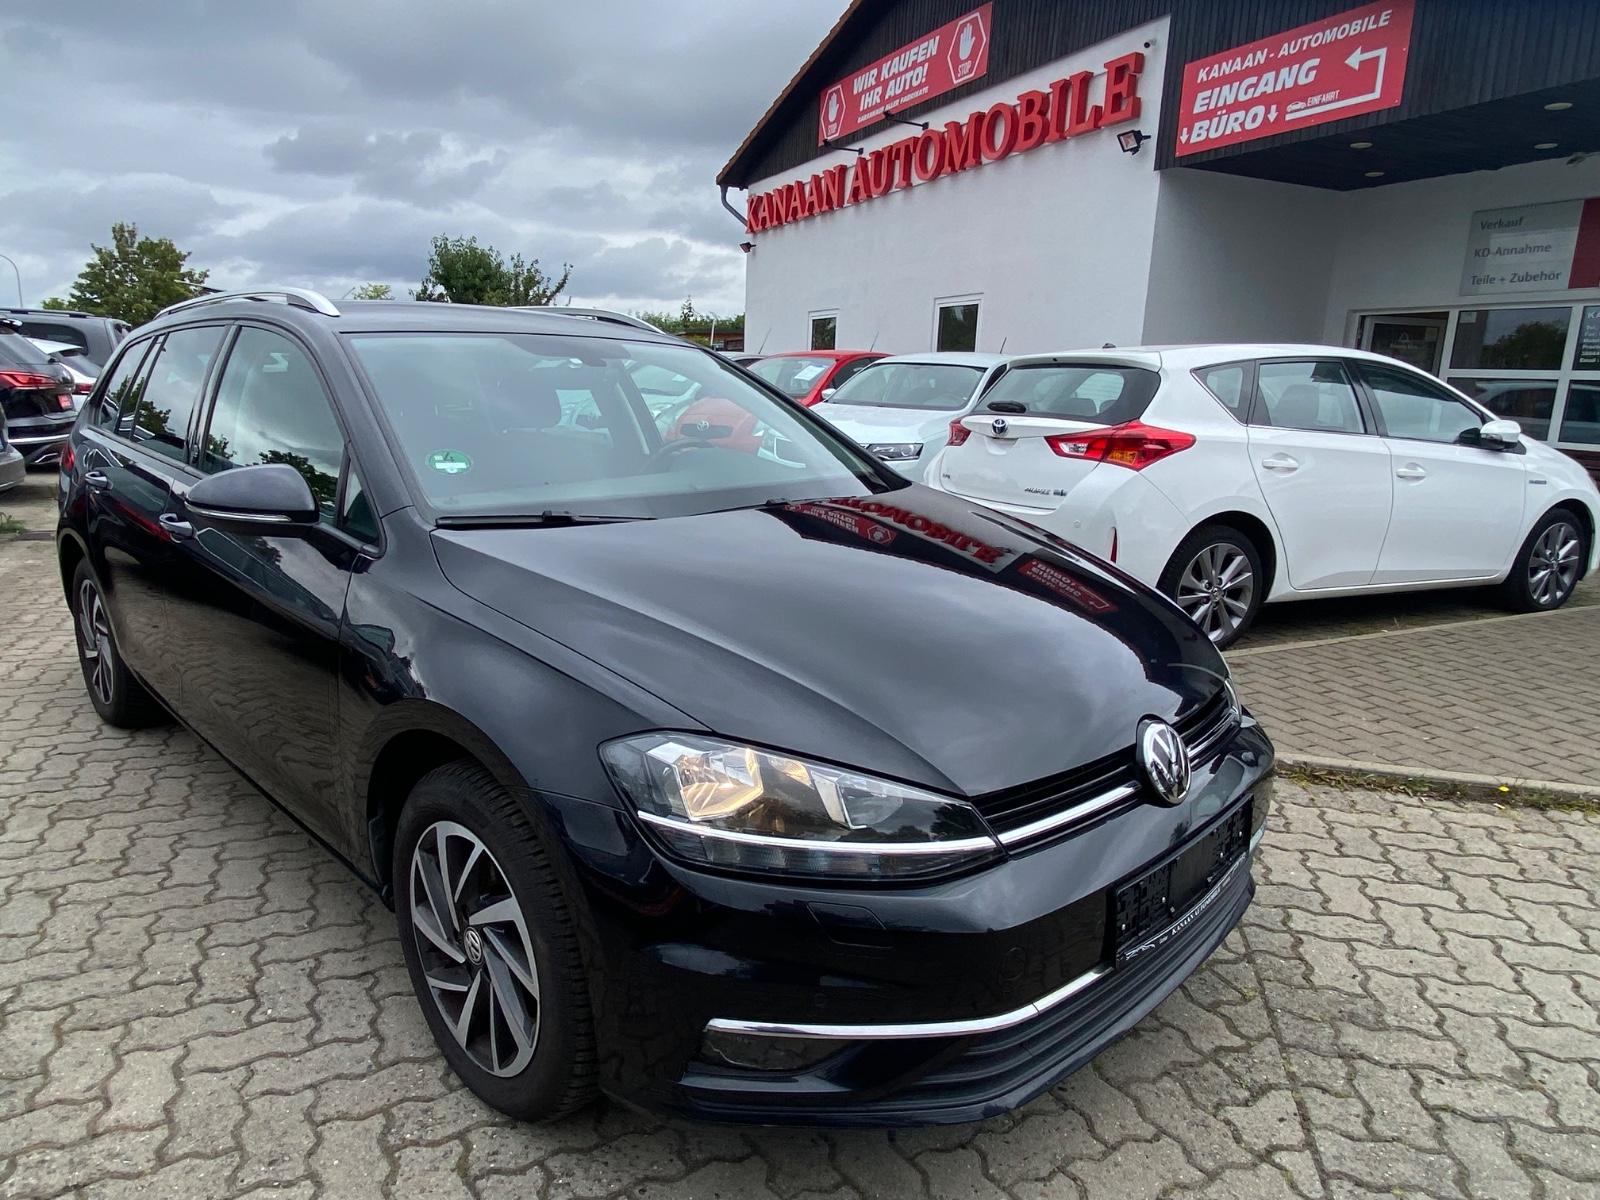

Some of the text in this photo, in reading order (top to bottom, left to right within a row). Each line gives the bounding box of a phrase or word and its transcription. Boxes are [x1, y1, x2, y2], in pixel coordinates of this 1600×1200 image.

[853, 35, 940, 95] WIR KAUFEN
[1196, 49, 1267, 84] KANAAN
[1277, 9, 1392, 59] AUTOMOBILE
[860, 62, 929, 111] IHR AUTO!
[957, 61, 972, 77] STOP
[1193, 58, 1321, 114] EINGANG
[1307, 90, 1340, 107] EINFAHRT
[745, 52, 1145, 234] KANAAN AUTOMOBILE
[1189, 105, 1266, 143] BÜRO
[1480, 216, 1523, 230] Verkauf
[1474, 244, 1552, 258] KD-Annahme
[1471, 274, 1496, 286] Teile
[1509, 270, 1562, 284] Zubehör
